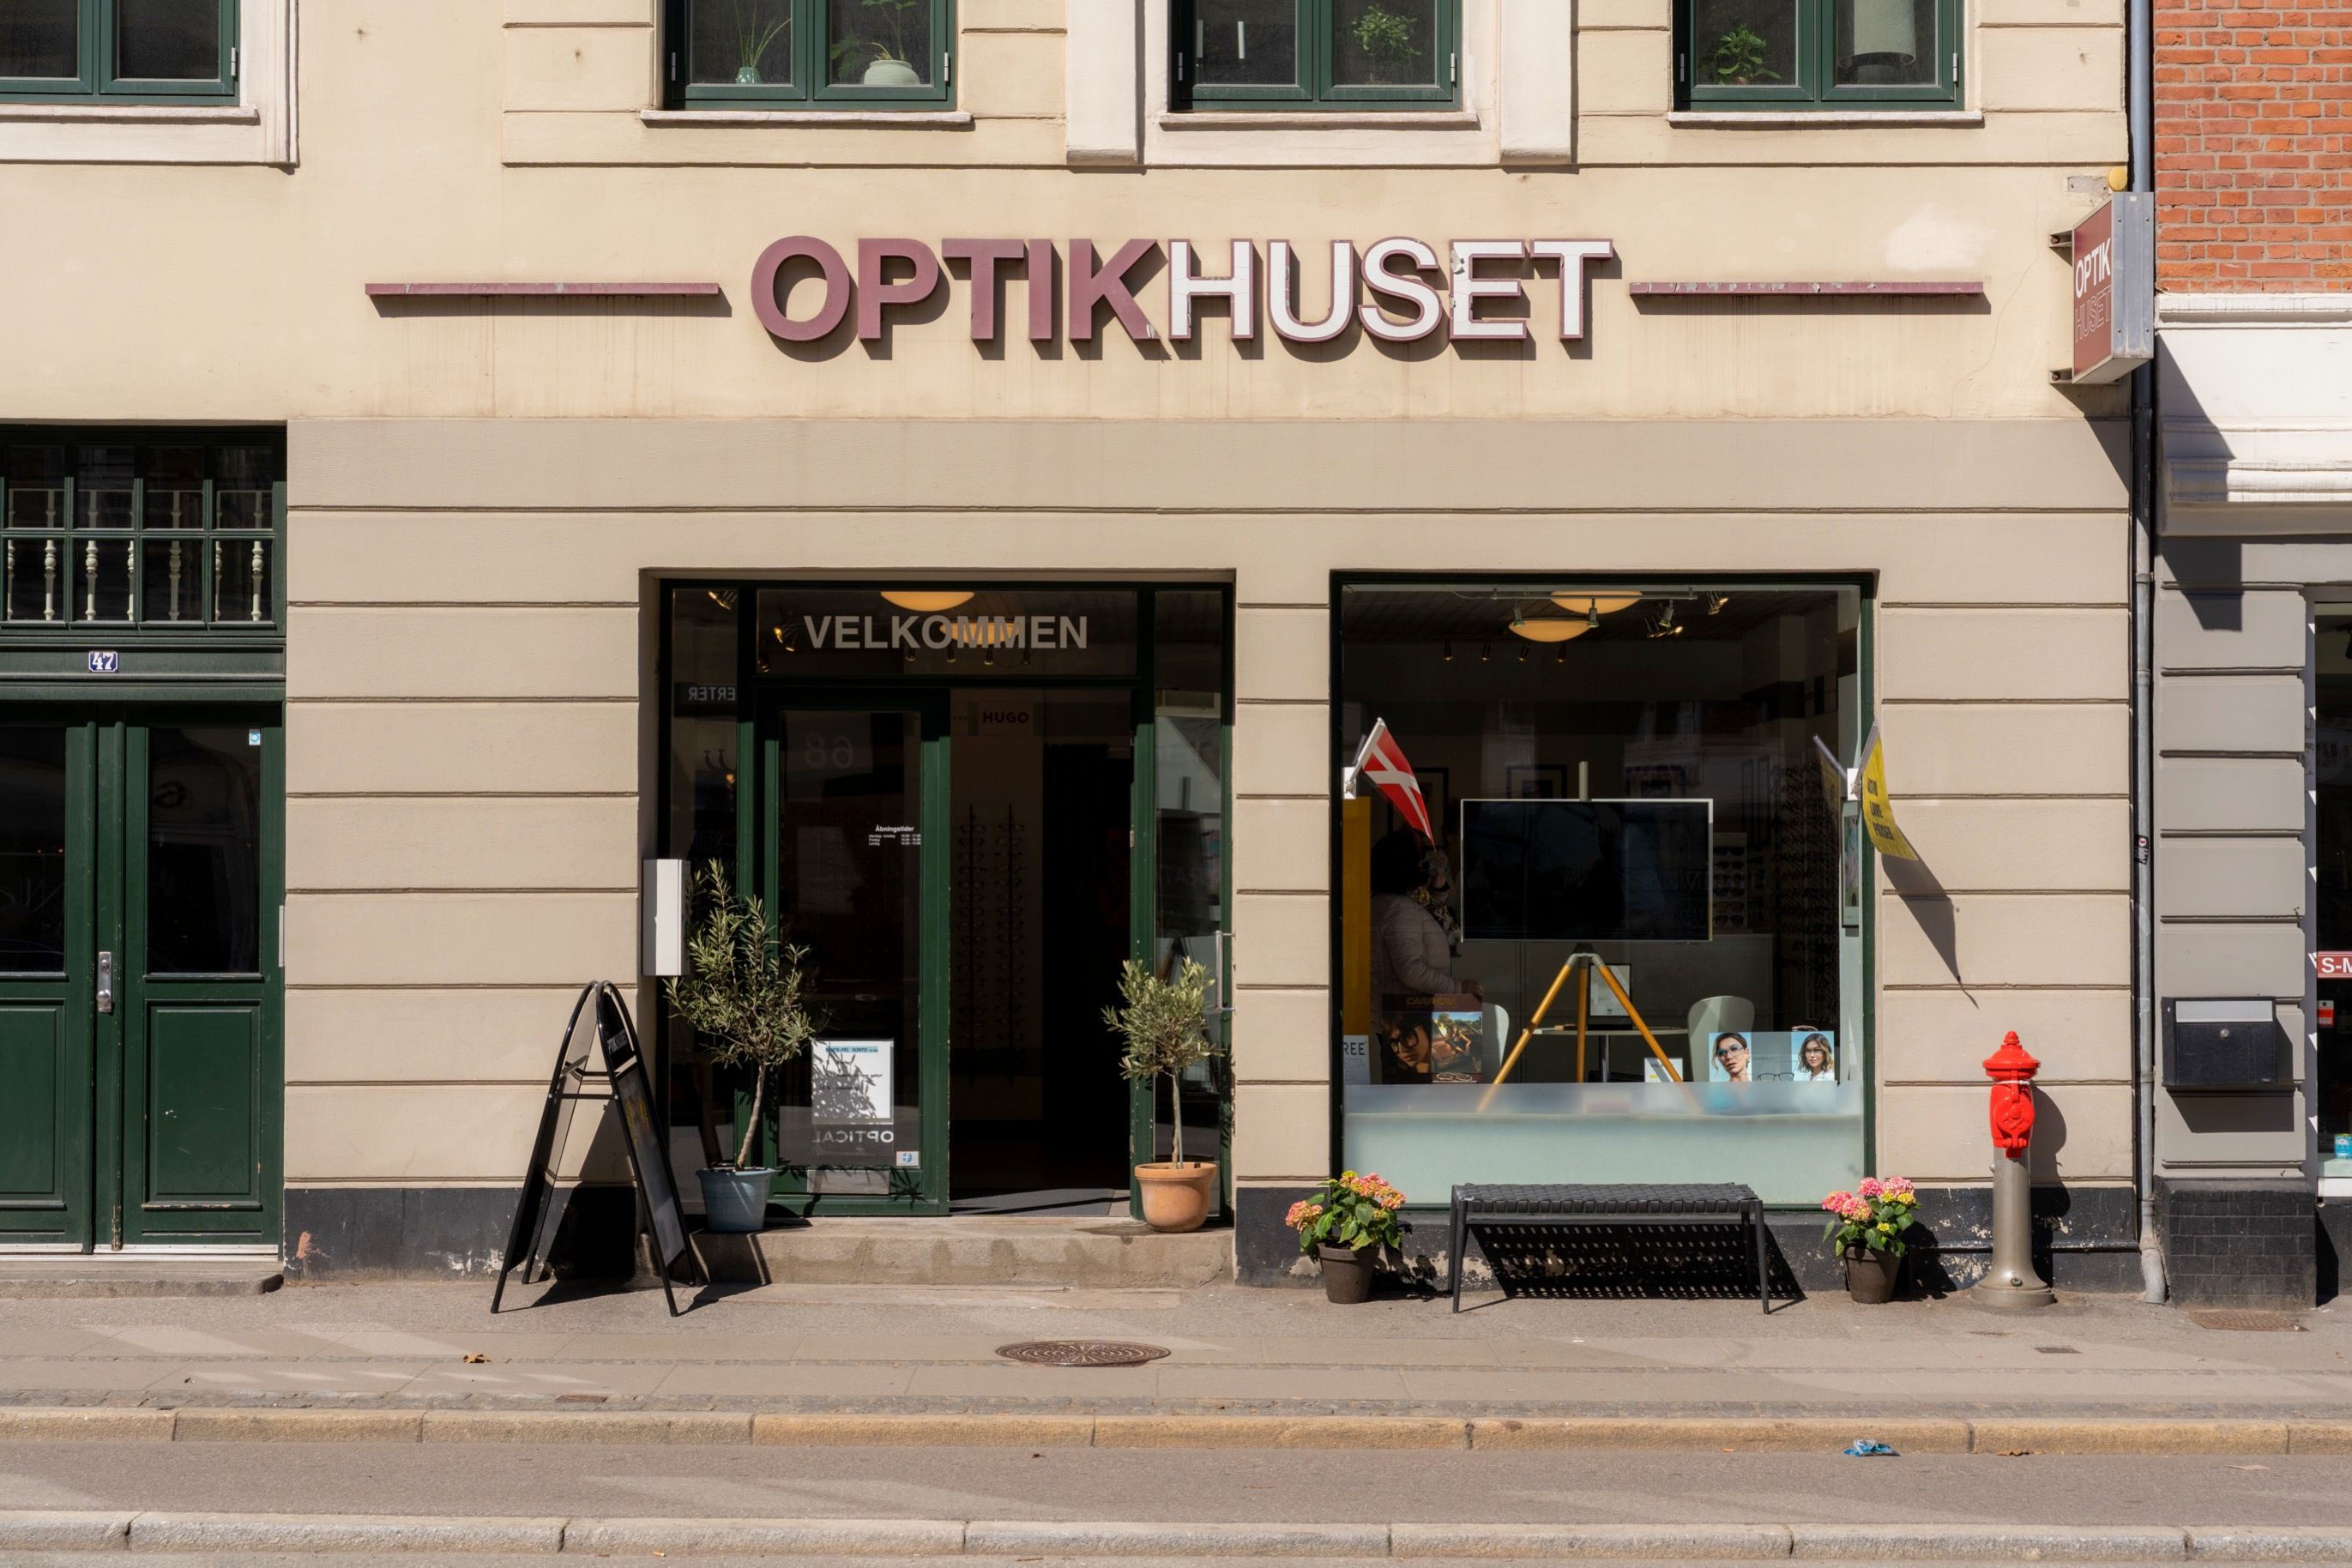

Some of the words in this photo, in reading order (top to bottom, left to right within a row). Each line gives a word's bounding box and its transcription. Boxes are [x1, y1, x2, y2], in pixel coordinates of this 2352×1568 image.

[2075, 238, 2113, 299] OPTIK
[750, 234, 1613, 342] OPTIKHUSET
[2075, 285, 2113, 343] HUSET
[804, 615, 1088, 649] VELKOMMEN
[92, 651, 114, 670] 47
[982, 711, 1029, 723] HUGO
[875, 824, 914, 833] Åbningstider
[1406, 997, 1456, 1006] CARRERA
